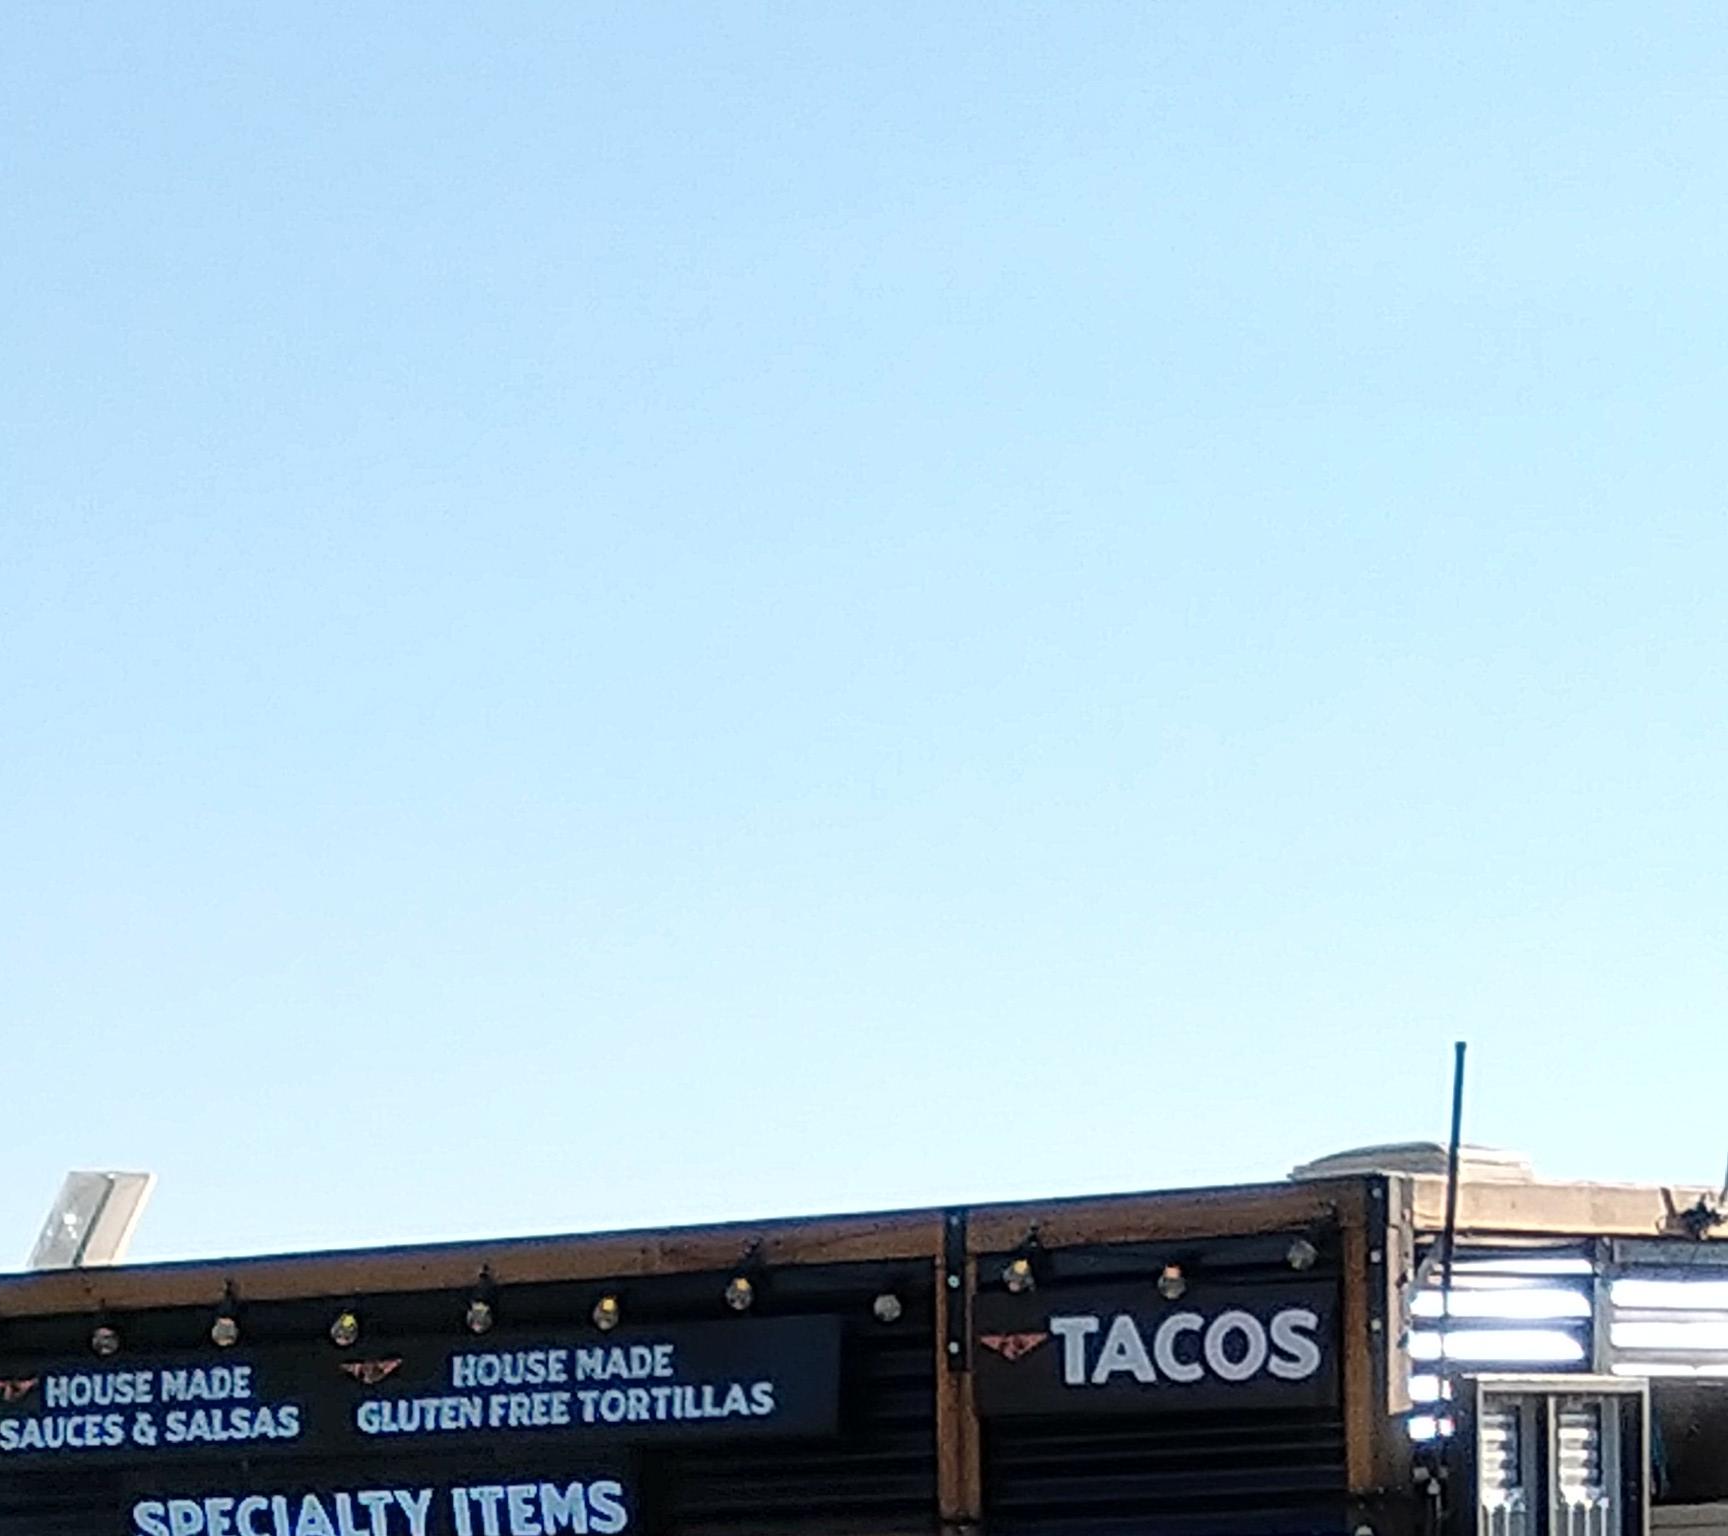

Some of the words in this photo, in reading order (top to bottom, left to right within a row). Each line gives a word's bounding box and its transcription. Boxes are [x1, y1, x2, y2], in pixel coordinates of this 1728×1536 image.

[452, 1350, 569, 1387] HOUSE
[576, 1345, 674, 1381] MADE
[1050, 1309, 1322, 1385] TACOS
[45, 1370, 153, 1407] HOUSE
[161, 1366, 252, 1402] MADE
[132, 1412, 157, 1446] &
[165, 1406, 300, 1443] SALSAS
[357, 1395, 482, 1434] GLUTEN
[489, 1391, 570, 1427] FREE
[577, 1382, 774, 1424] TORTILLAS
